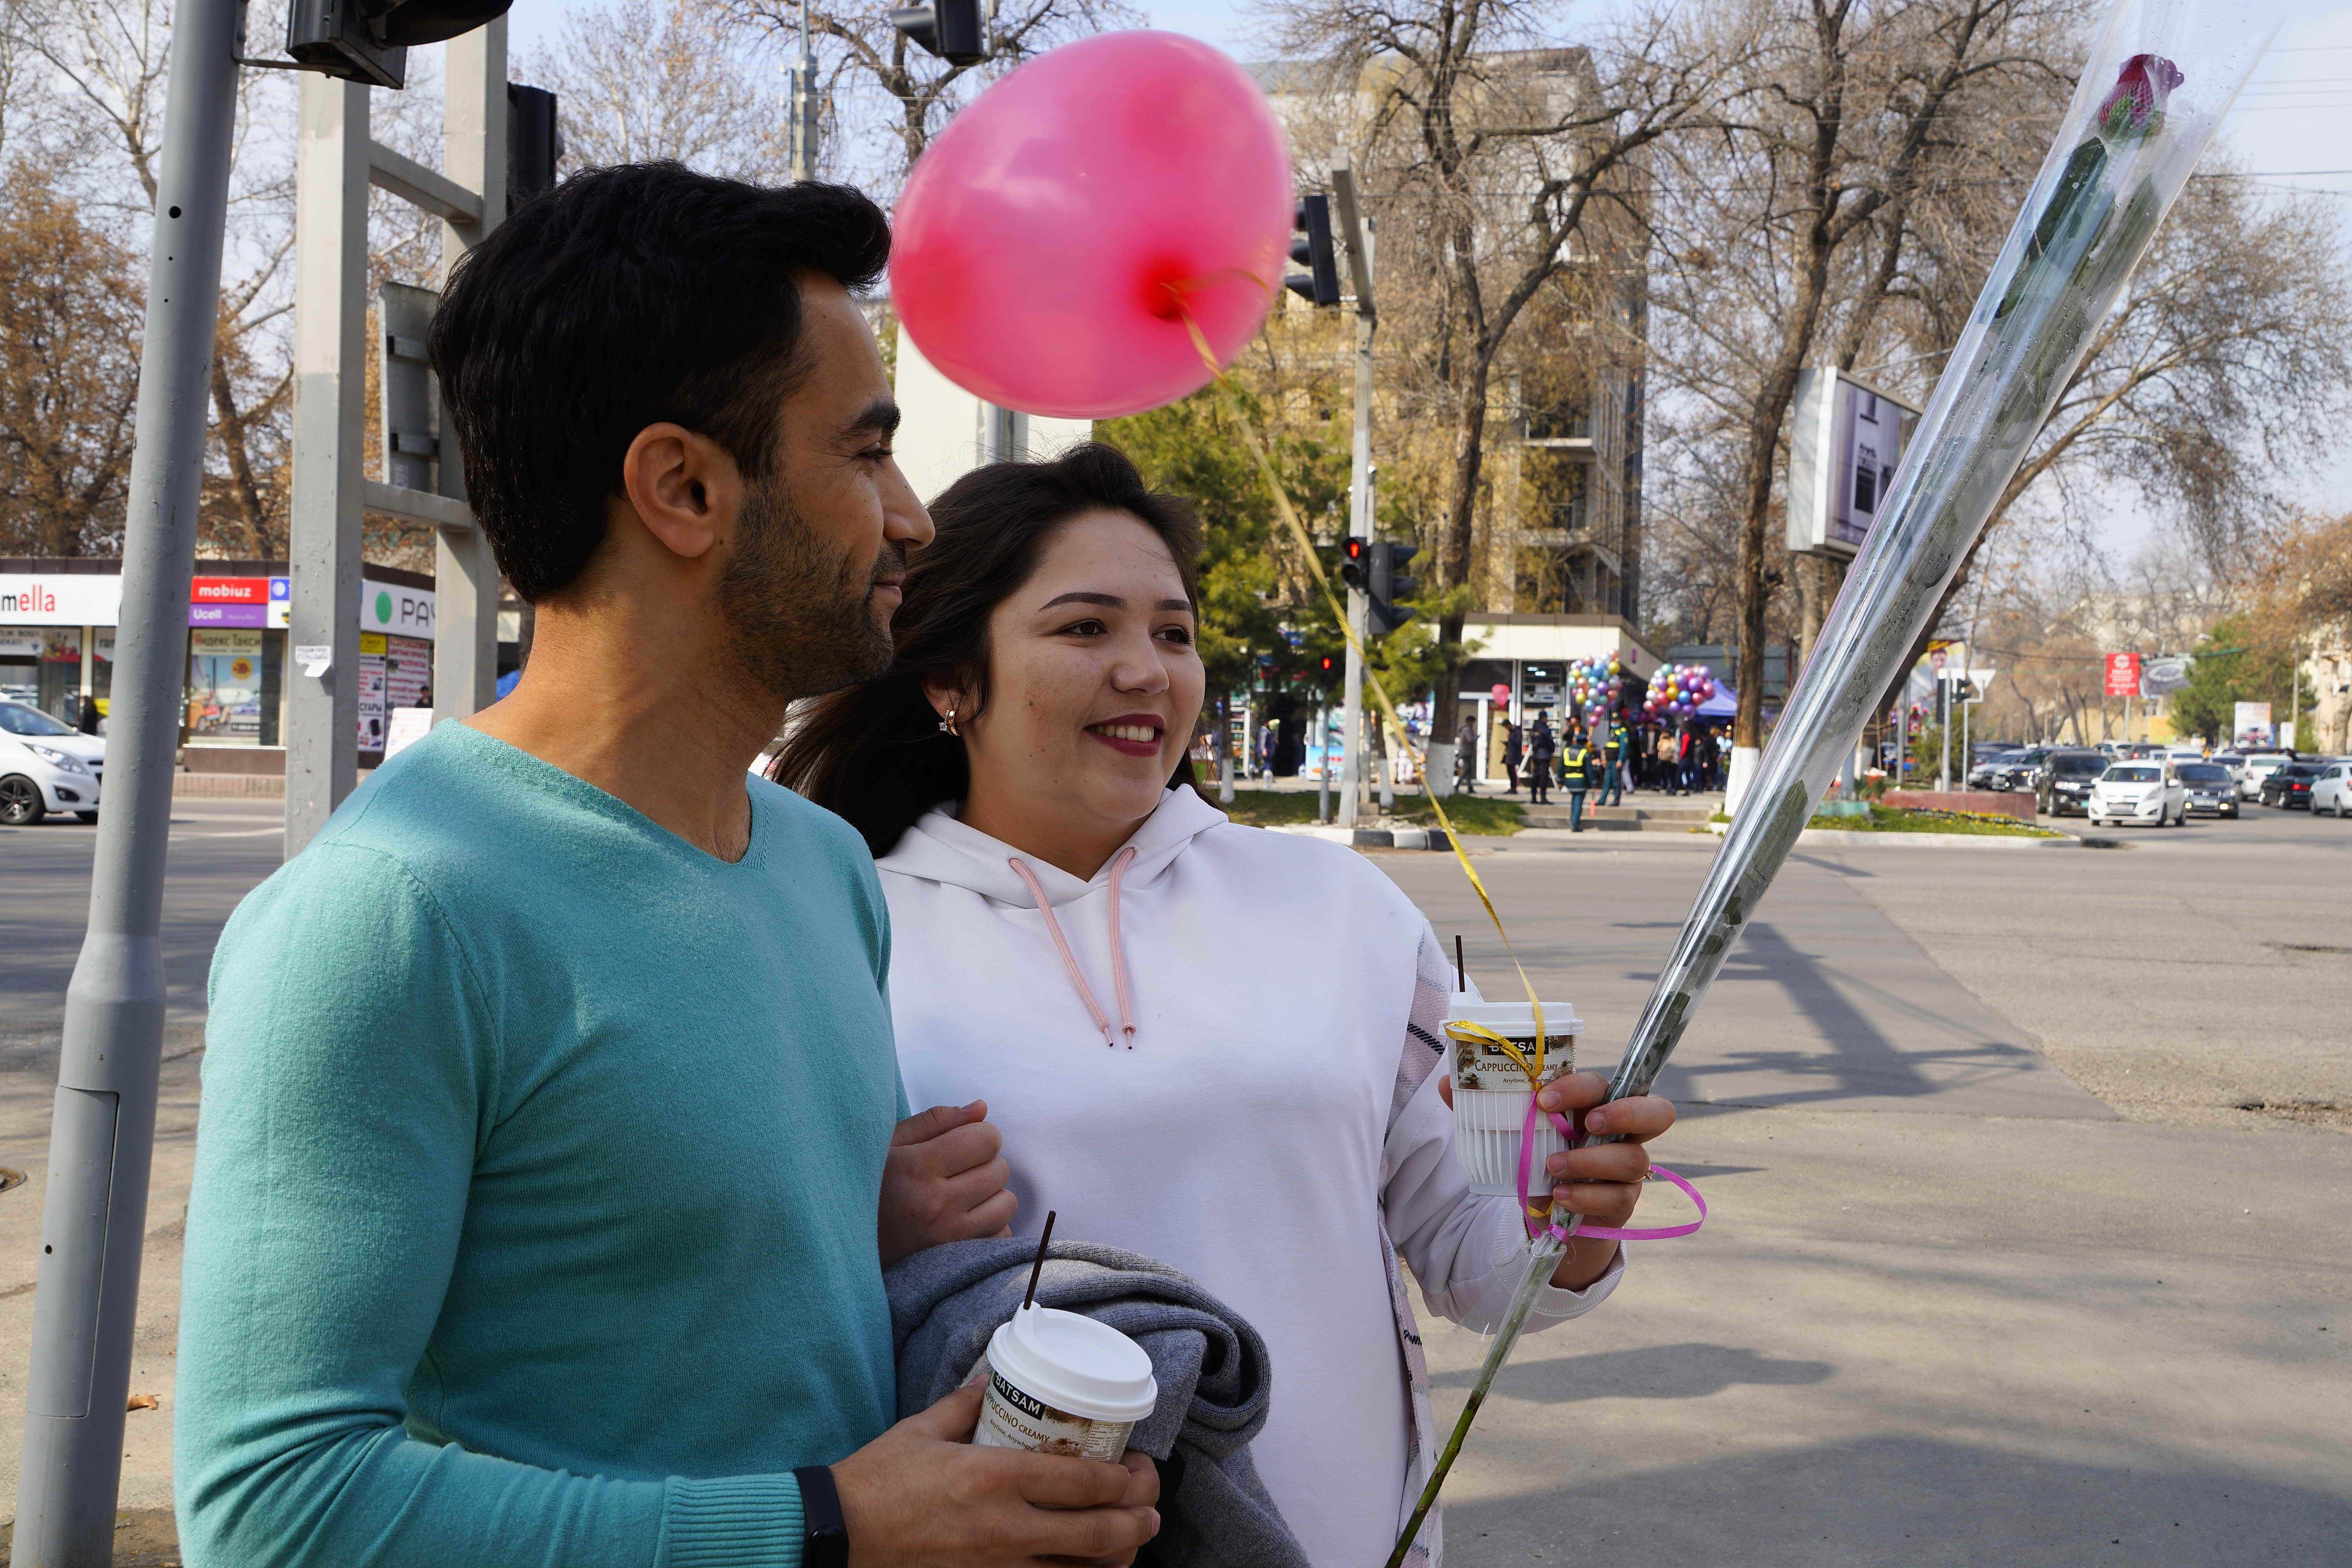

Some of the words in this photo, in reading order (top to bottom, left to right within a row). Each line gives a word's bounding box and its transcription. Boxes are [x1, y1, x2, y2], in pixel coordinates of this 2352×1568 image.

[2, 585, 55, 611] mella
[199, 584, 251, 597] mobiuz
[193, 608, 221, 620] Ucell
[1488, 1042, 1545, 1052] BSA
[995, 1374, 1041, 1415] BATSAM
[989, 1419, 1006, 1438] Anytime,
[1019, 1425, 1050, 1443] CREAMY
